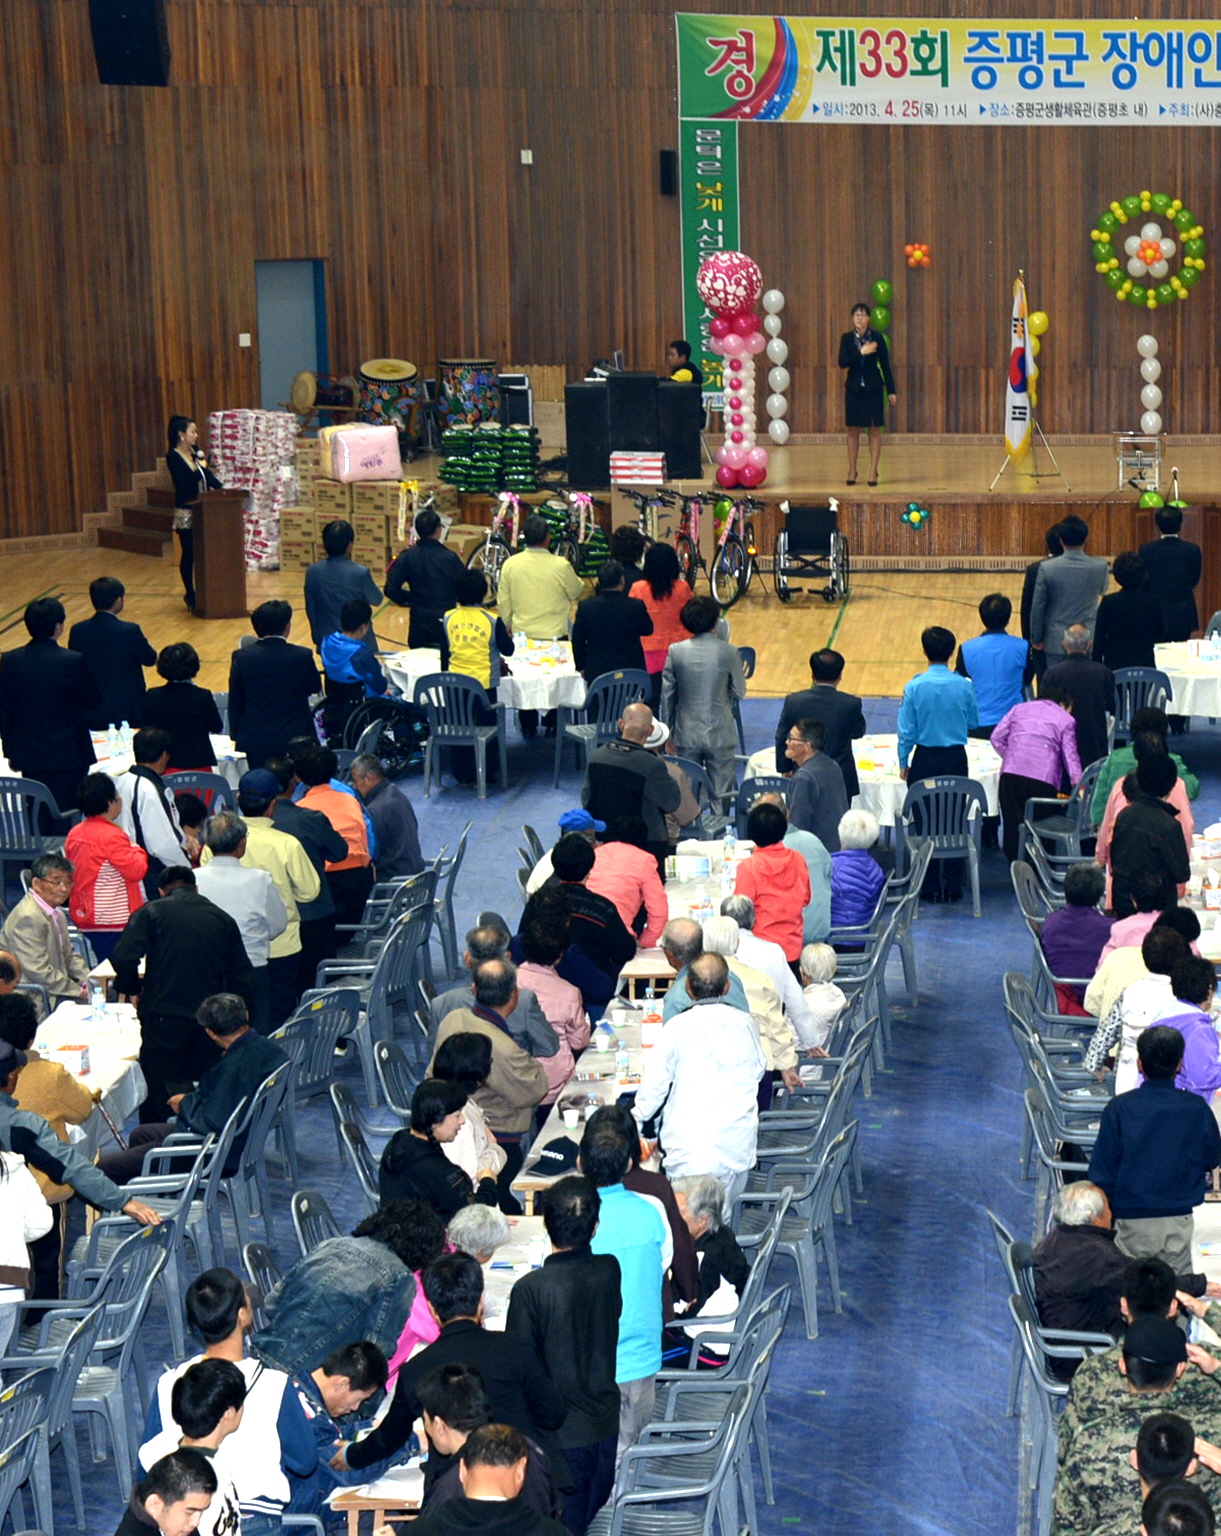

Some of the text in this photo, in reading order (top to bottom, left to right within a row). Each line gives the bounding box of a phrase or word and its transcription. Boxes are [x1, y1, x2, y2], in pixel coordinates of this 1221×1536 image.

[705, 29, 757, 100] 경
[814, 28, 950, 89] 제33회
[963, 30, 1089, 90] 증평군
[944, 102, 967, 118] 11시
